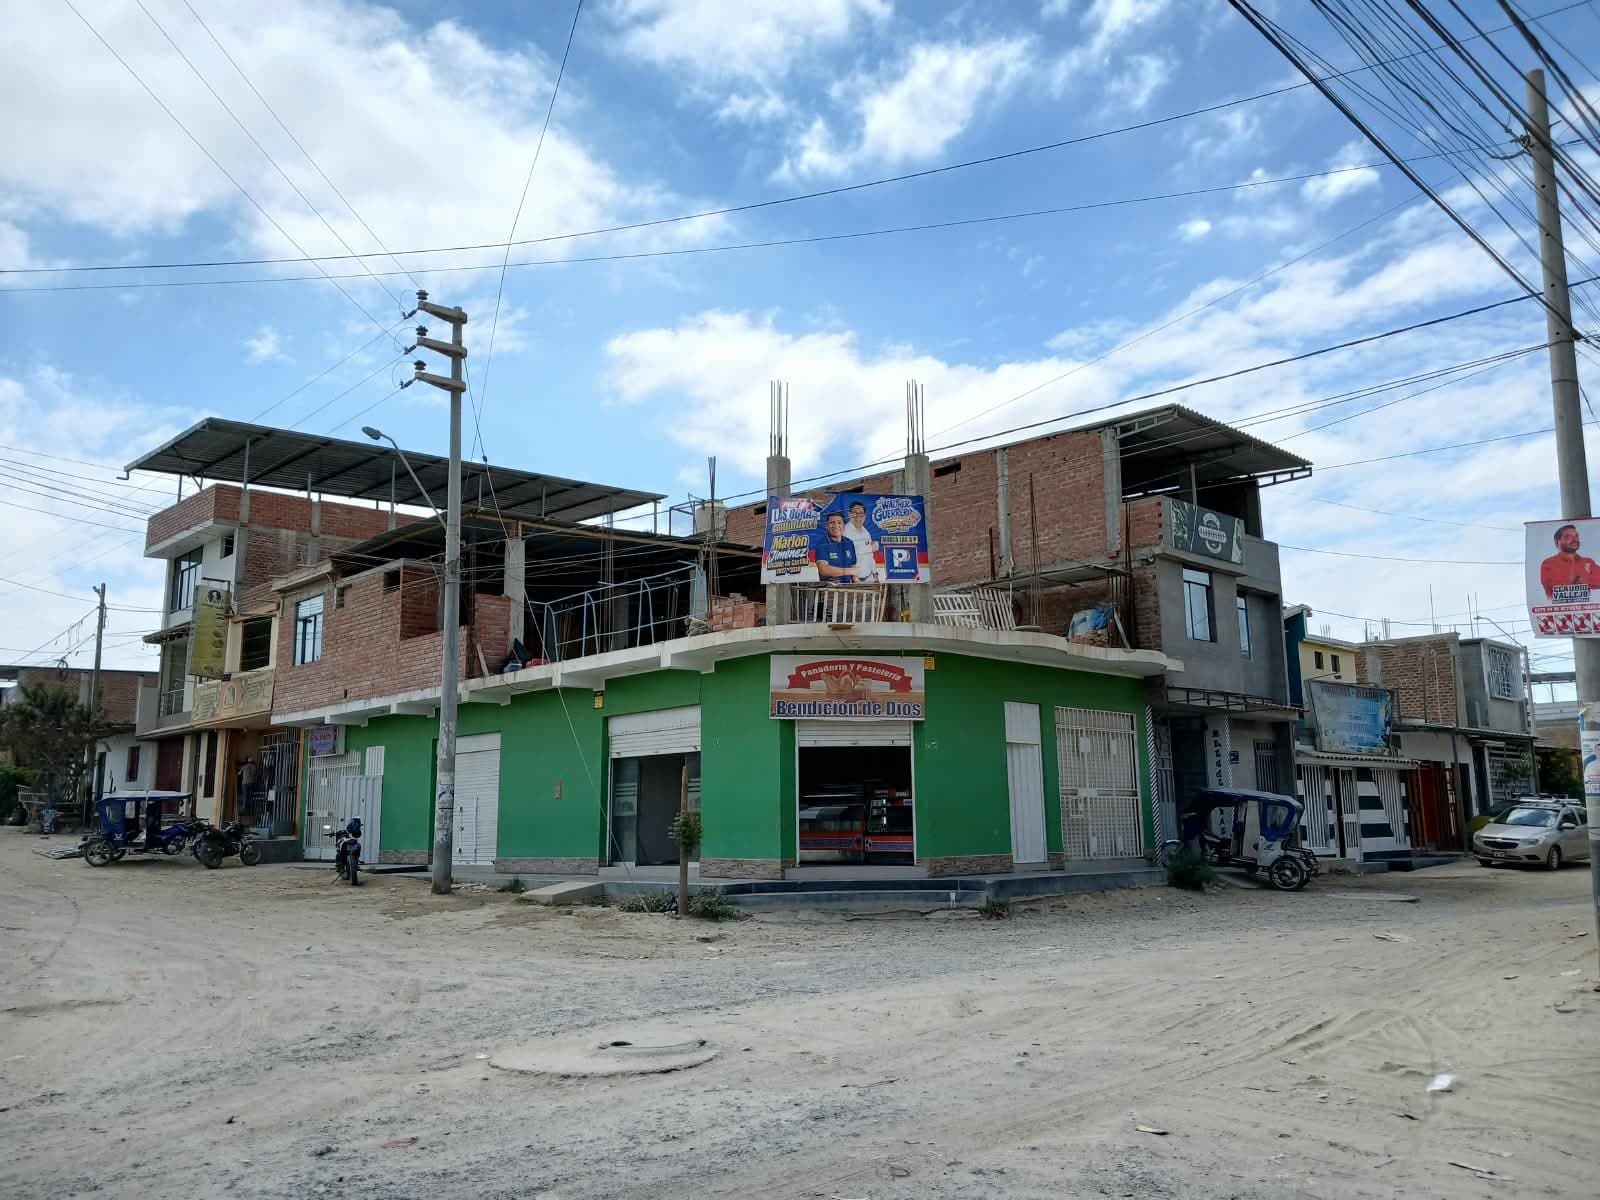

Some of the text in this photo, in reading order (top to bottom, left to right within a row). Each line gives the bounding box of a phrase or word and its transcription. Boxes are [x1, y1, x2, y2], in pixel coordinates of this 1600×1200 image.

[773, 534, 808, 551] Marlon
[1553, 584, 1588, 593] CLAUDIO
[1553, 590, 1588, 599] VALLEJO
[776, 698, 921, 716] Bendición de Dios
